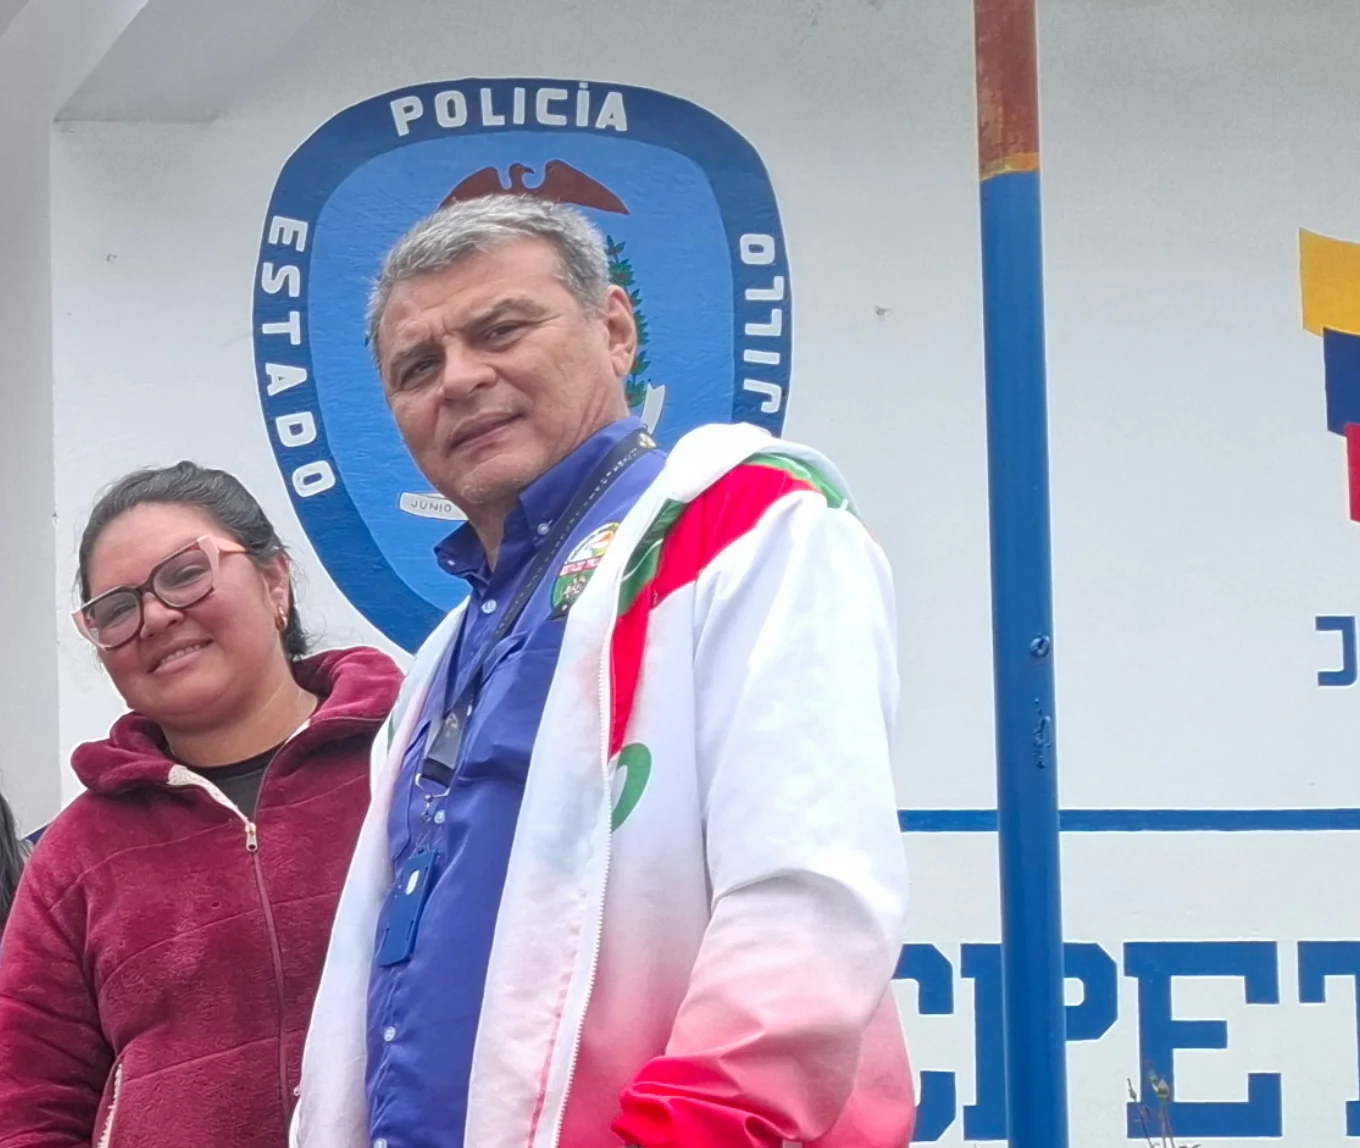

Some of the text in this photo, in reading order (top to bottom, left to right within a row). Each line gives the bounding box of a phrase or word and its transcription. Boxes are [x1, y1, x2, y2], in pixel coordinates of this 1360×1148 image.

[261, 216, 336, 498] ESTADO
[739, 234, 785, 413] JILLO
[411, 500, 452, 513] JUNIO
